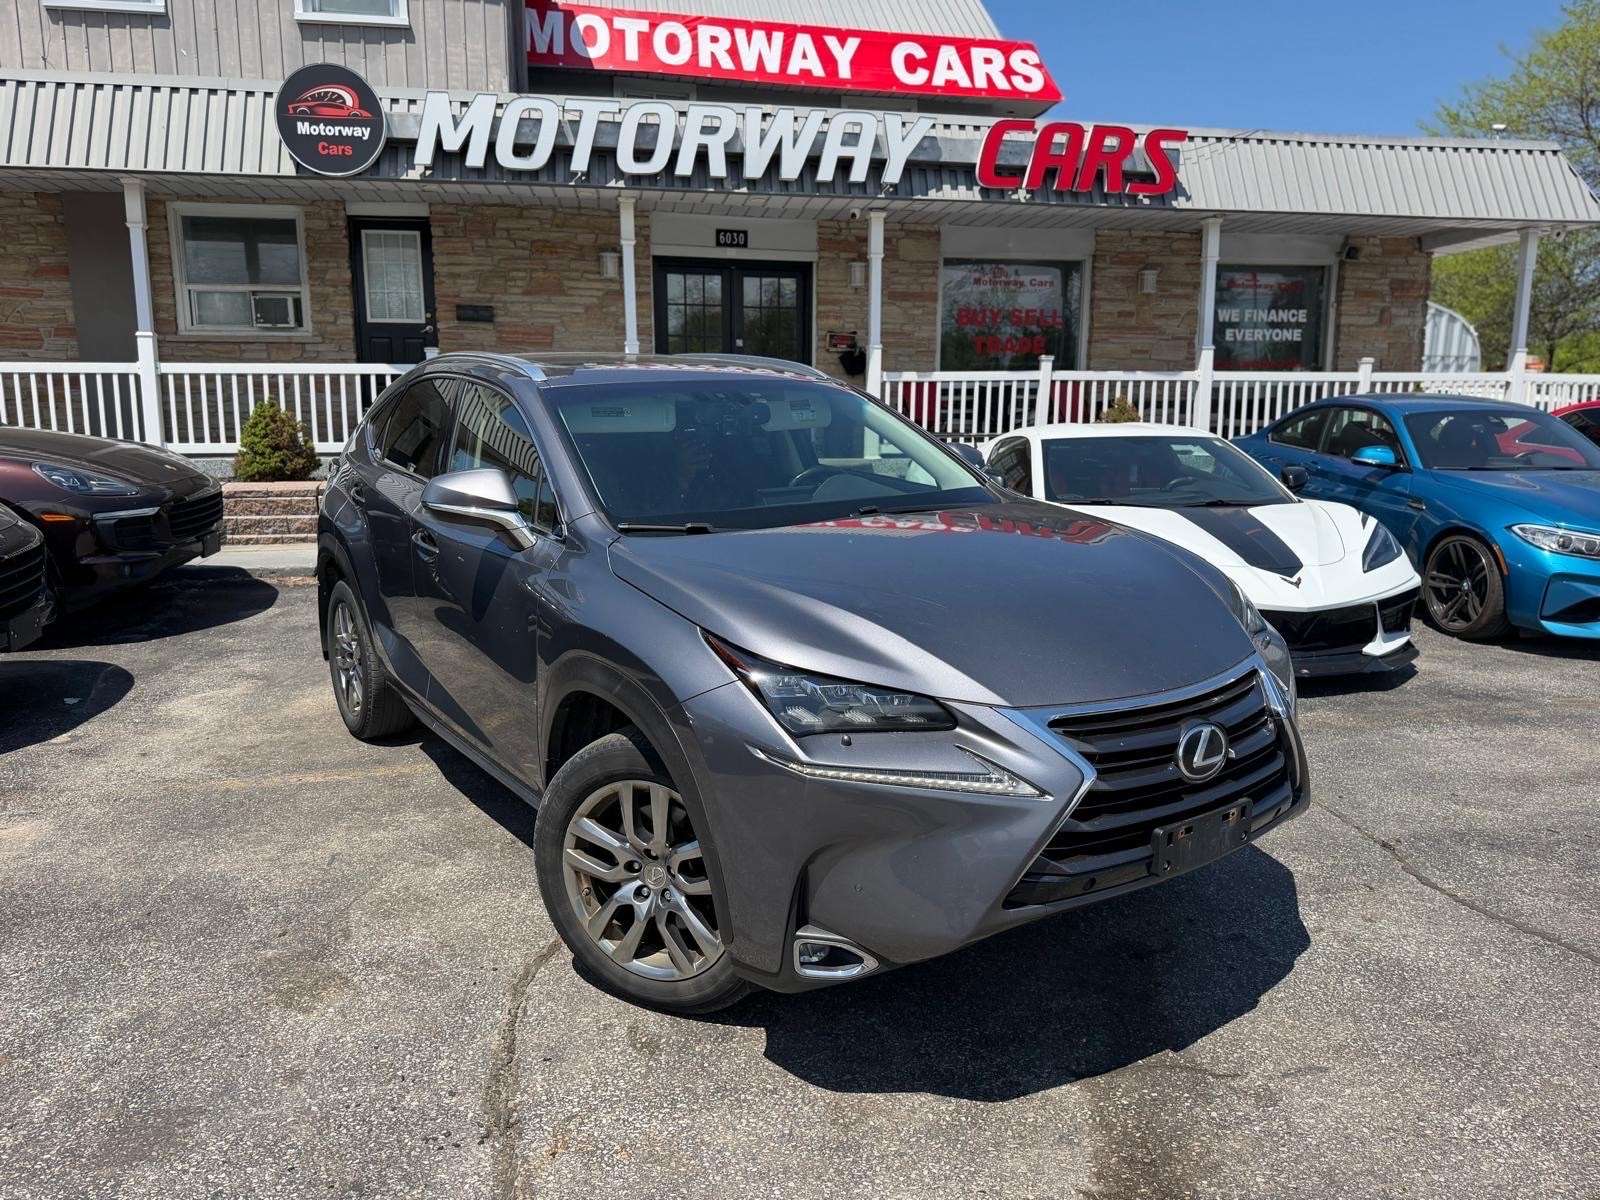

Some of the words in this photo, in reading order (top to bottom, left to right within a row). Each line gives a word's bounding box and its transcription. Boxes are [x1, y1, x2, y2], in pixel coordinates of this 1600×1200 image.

[525, 7, 862, 81] MOTORWAY
[890, 41, 1046, 94] CARS
[296, 121, 371, 140] Motorway
[317, 141, 353, 156] Cars
[413, 90, 938, 185] MOTORWAY
[975, 118, 1189, 196] CARS
[719, 231, 745, 245] 6030
[957, 308, 1003, 327] BUY
[1011, 308, 1063, 328] SELL
[1217, 308, 1240, 323] WE
[1244, 308, 1308, 323] FINANCE
[1224, 328, 1302, 342] EVERYONE
